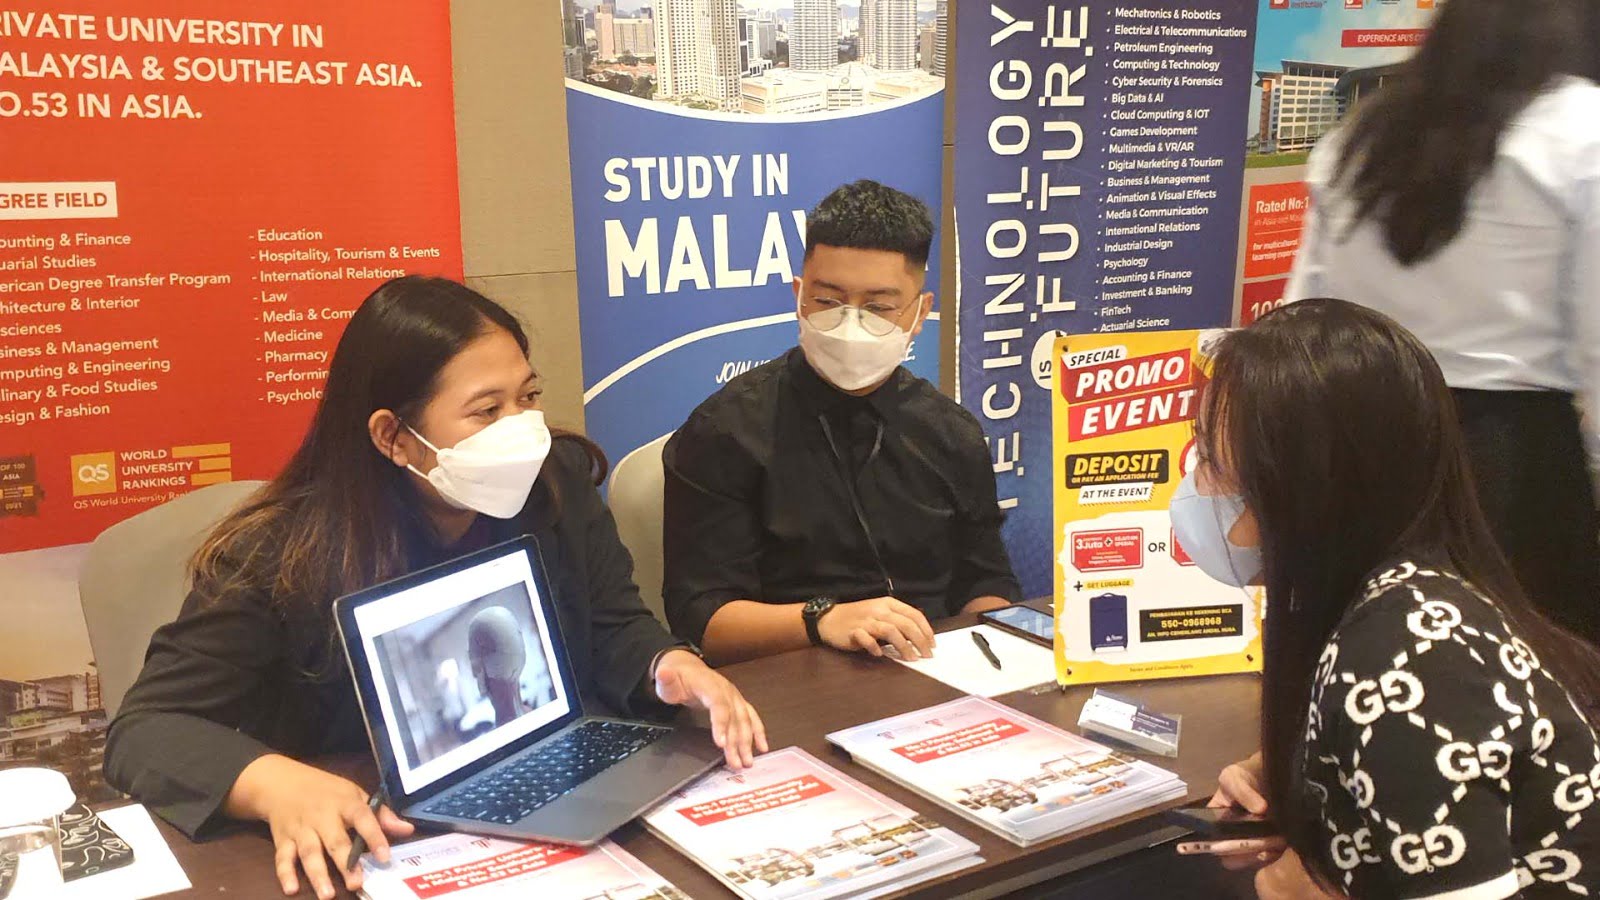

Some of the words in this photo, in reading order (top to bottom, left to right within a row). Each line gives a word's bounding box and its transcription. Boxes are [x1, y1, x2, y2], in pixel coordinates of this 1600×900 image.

[1115, 8, 1172, 18] Mechatronics
[1173, 10, 1179, 19] &
[1181, 10, 1221, 20] Robotics
[0, 11, 97, 40] IVATE
[106, 16, 284, 47] UNIVERSITY
[292, 24, 323, 48] IN
[1114, 25, 1153, 35] Electrical
[1154, 26, 1160, 35] &
[1161, 26, 1247, 37] Telecommunications
[1114, 42, 1157, 52] Petroleum
[1159, 43, 1213, 55] Engineering
[142, 56, 165, 81] &
[174, 57, 348, 85] SOUTHEAST
[355, 63, 422, 88] ASIA.
[1113, 59, 1160, 71] Computing
[1161, 60, 1167, 69] &
[1168, 60, 1220, 72] Technology
[1112, 76, 1137, 88] Cyber
[1139, 76, 1172, 88] Security
[1173, 77, 1180, 86] &
[1181, 77, 1223, 86] Forensics
[78, 93, 111, 118] IN
[121, 93, 203, 119] ASIA.
[1112, 93, 1126, 105] Big
[1127, 93, 1146, 103] Data
[1147, 94, 1153, 102] &
[1154, 93, 1164, 102] AI
[1111, 110, 1136, 119] Cloud
[1137, 109, 1184, 121] Computing
[1186, 109, 1193, 119] &
[1194, 109, 1210, 118] IOT
[1110, 127, 1139, 137] Games
[1139, 126, 1198, 137] Development
[1109, 143, 1156, 153] Multimedia
[1157, 143, 1163, 152] &
[1164, 141, 1194, 152] VR/AR
[1033, 5, 1093, 322] FUTURE
[1108, 160, 1135, 172] Digital
[1136, 159, 1179, 170] Marketing
[1181, 158, 1187, 167] &
[1189, 157, 1223, 167] Tourism
[603, 154, 741, 203] STUDY
[752, 153, 789, 197] IN
[1107, 176, 1142, 186] Business
[1144, 176, 1150, 185] &
[1150, 174, 1210, 185] Management
[54, 192, 108, 208] FIELD
[1106, 192, 1149, 203] Animation
[1150, 191, 1156, 200] &
[1158, 190, 1185, 200] Visual
[1186, 189, 1217, 199] Effects
[1106, 209, 1131, 219] Media
[1132, 209, 1138, 218] &
[1139, 205, 1208, 217] Communication
[1256, 198, 1286, 214] Rated
[257, 229, 323, 242] Education
[1105, 224, 1157, 236] International
[1158, 222, 1200, 232] Relations
[59, 233, 71, 247] &
[75, 233, 132, 246] Finance
[1104, 240, 1142, 252] Industrial
[1143, 239, 1173, 250] Design
[42, 255, 96, 269] Studies
[259, 248, 331, 264] Hospitality,
[334, 247, 385, 260] Tourism
[389, 246, 399, 259] &
[403, 246, 440, 258] Events
[1103, 257, 1149, 269] Psychology
[260, 267, 343, 282] International
[346, 267, 406, 280] Relations
[1102, 272, 1148, 285] Accounting
[1149, 271, 1156, 280] &
[1157, 270, 1192, 280] Finance
[48, 277, 102, 293] Degree
[107, 273, 165, 288] Transfer
[169, 273, 231, 288] Program
[261, 291, 288, 303] Law
[1102, 289, 1146, 301] Investment
[1148, 287, 1154, 296] &
[1155, 285, 1192, 296] Banking
[70, 298, 82, 311] &
[86, 296, 140, 310] Interior
[263, 309, 304, 323] Media
[307, 308, 318, 320] &
[1101, 305, 1131, 317] FinTech
[0, 322, 62, 336] sciences
[1100, 320, 1135, 332] Actuarial
[1136, 318, 1170, 328] Science
[264, 329, 323, 343] Medicine
[46, 342, 57, 355] &
[62, 337, 159, 355] Management
[265, 350, 328, 363] Pharmacy
[1070, 348, 1121, 367] SPECIAL
[67, 362, 79, 375] &
[83, 357, 171, 376] Engineering
[1075, 356, 1185, 398] PROMO
[46, 385, 57, 399] &
[62, 381, 99, 397] Food
[104, 378, 158, 393] Studies
[39, 406, 51, 420] &
[55, 403, 110, 418] Fashion
[1081, 389, 1195, 435] EVENT
[120, 449, 167, 462] WORLD
[122, 461, 193, 476] UNIVERSITY
[1073, 453, 1162, 476] DEPOSIT
[78, 463, 110, 484] QS
[122, 476, 186, 490] RANKINGS
[1082, 490, 1094, 499] AT
[1097, 489, 1114, 498] THE
[1118, 487, 1150, 497] EVENT
[73, 500, 88, 509] QS
[90, 497, 118, 507] World
[121, 493, 166, 504] University
[1147, 541, 1166, 553] OR
[1100, 580, 1130, 588] LUGGAGE
